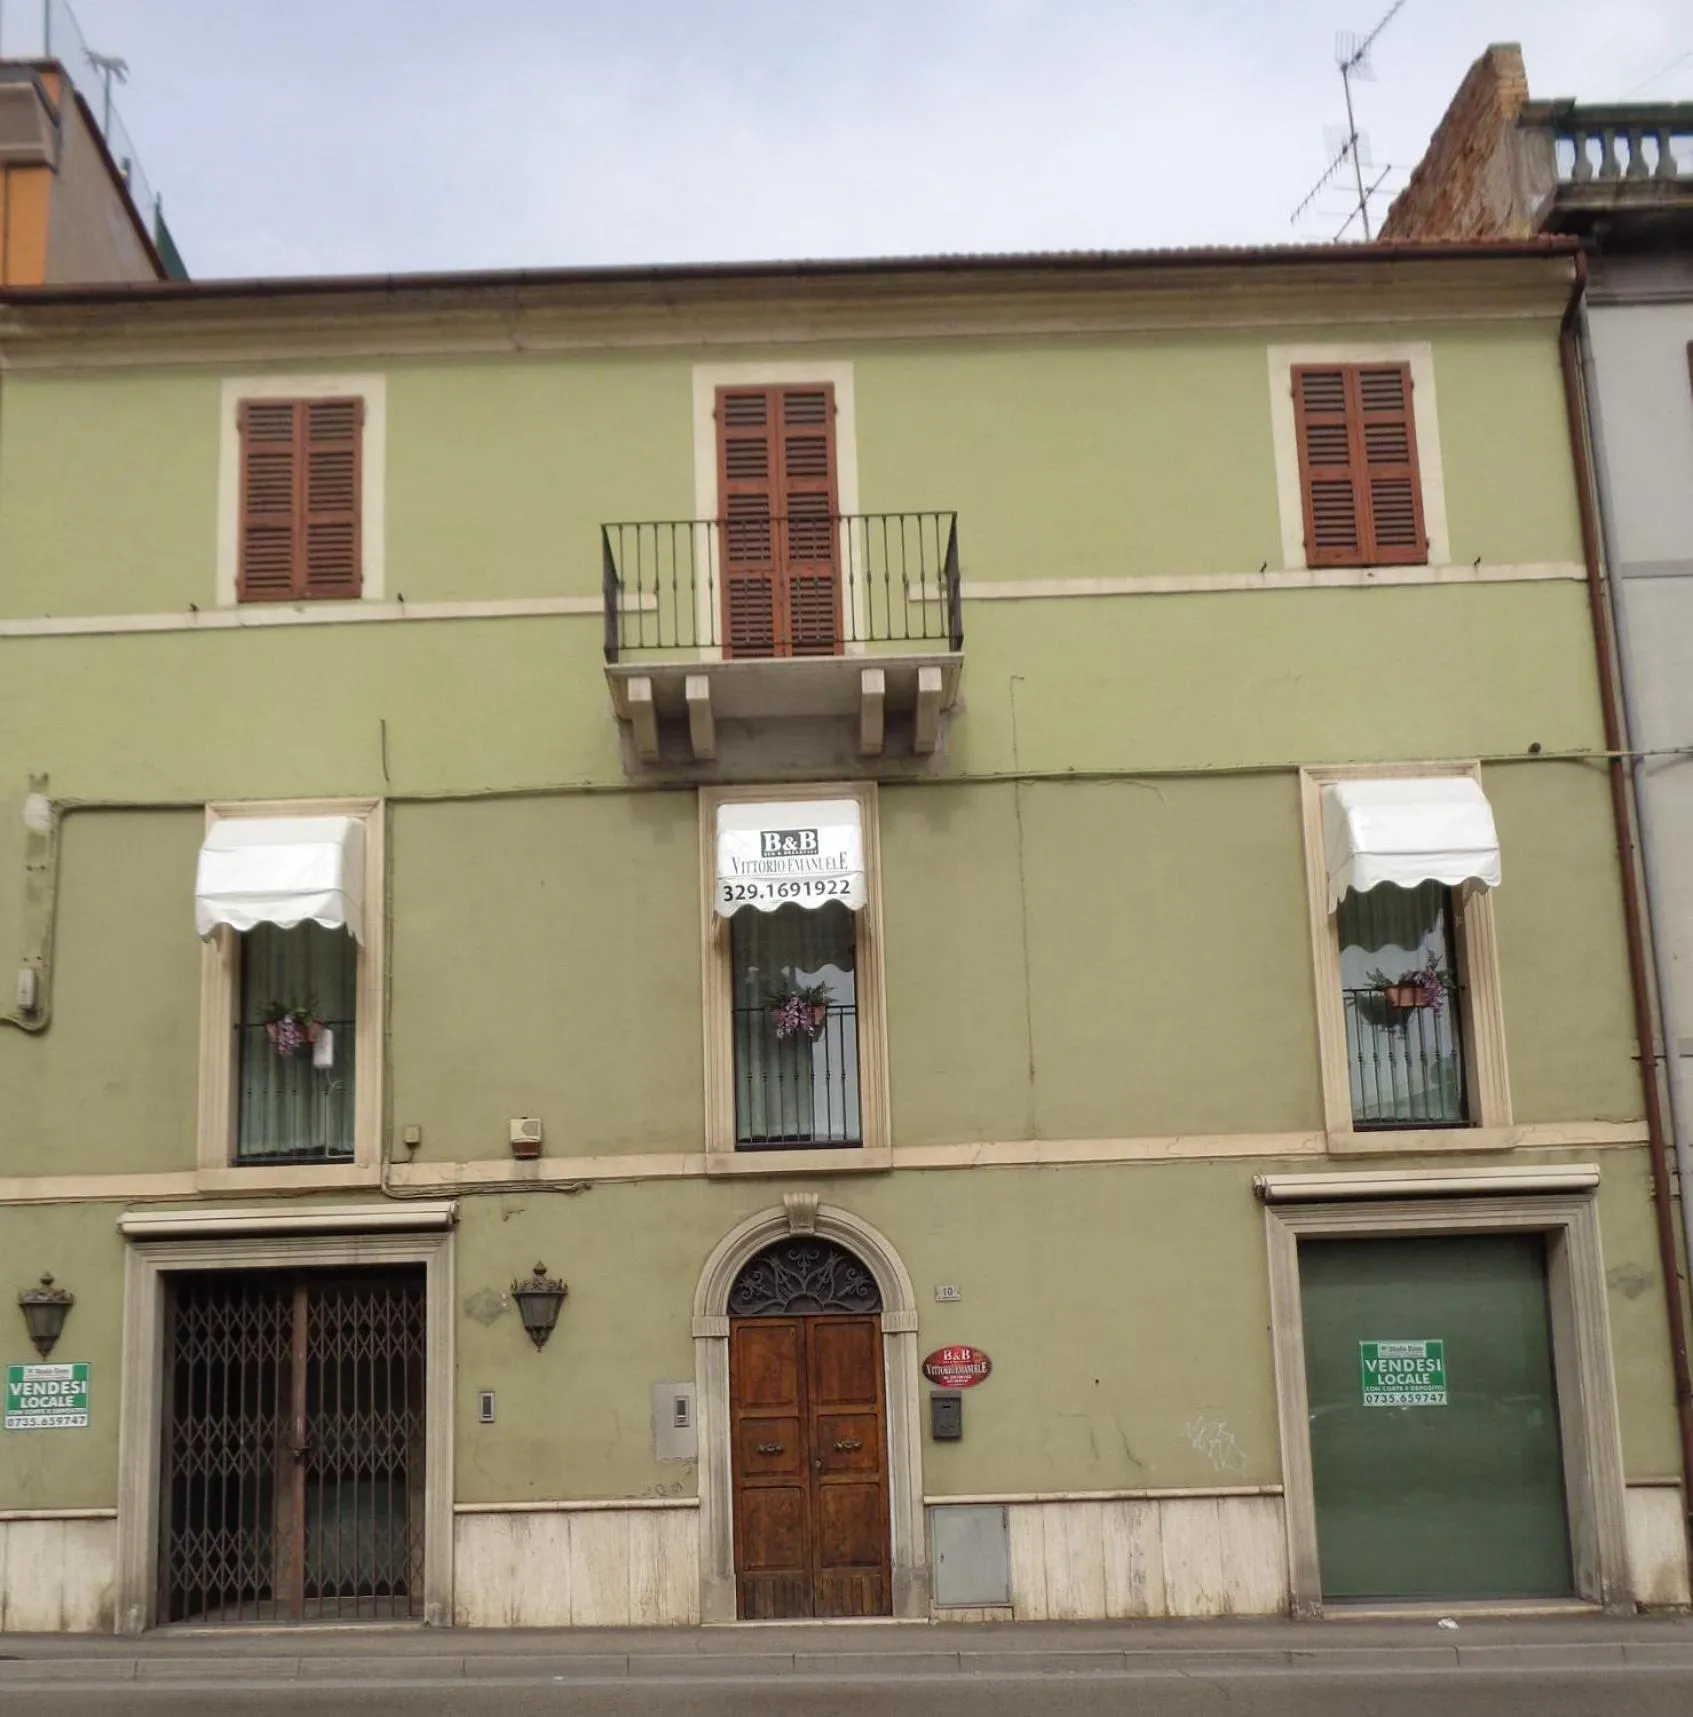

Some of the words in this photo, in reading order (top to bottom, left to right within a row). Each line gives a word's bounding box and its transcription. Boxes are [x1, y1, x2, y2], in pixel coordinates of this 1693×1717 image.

[764, 831, 817, 851] B&B
[731, 856, 785, 875] VITTORIO
[788, 852, 848, 873] EMANUELE
[723, 880, 850, 901] 329.1691922
[943, 1287, 954, 1297] 10
[943, 1349, 971, 1361] B&B
[1365, 1359, 1441, 1372] VENDESI
[1377, 1373, 1430, 1385] LOCALE
[9, 1381, 87, 1395] VENDESI
[21, 1396, 75, 1408] LOCALE
[1366, 1393, 1444, 1403] 0735.659747
